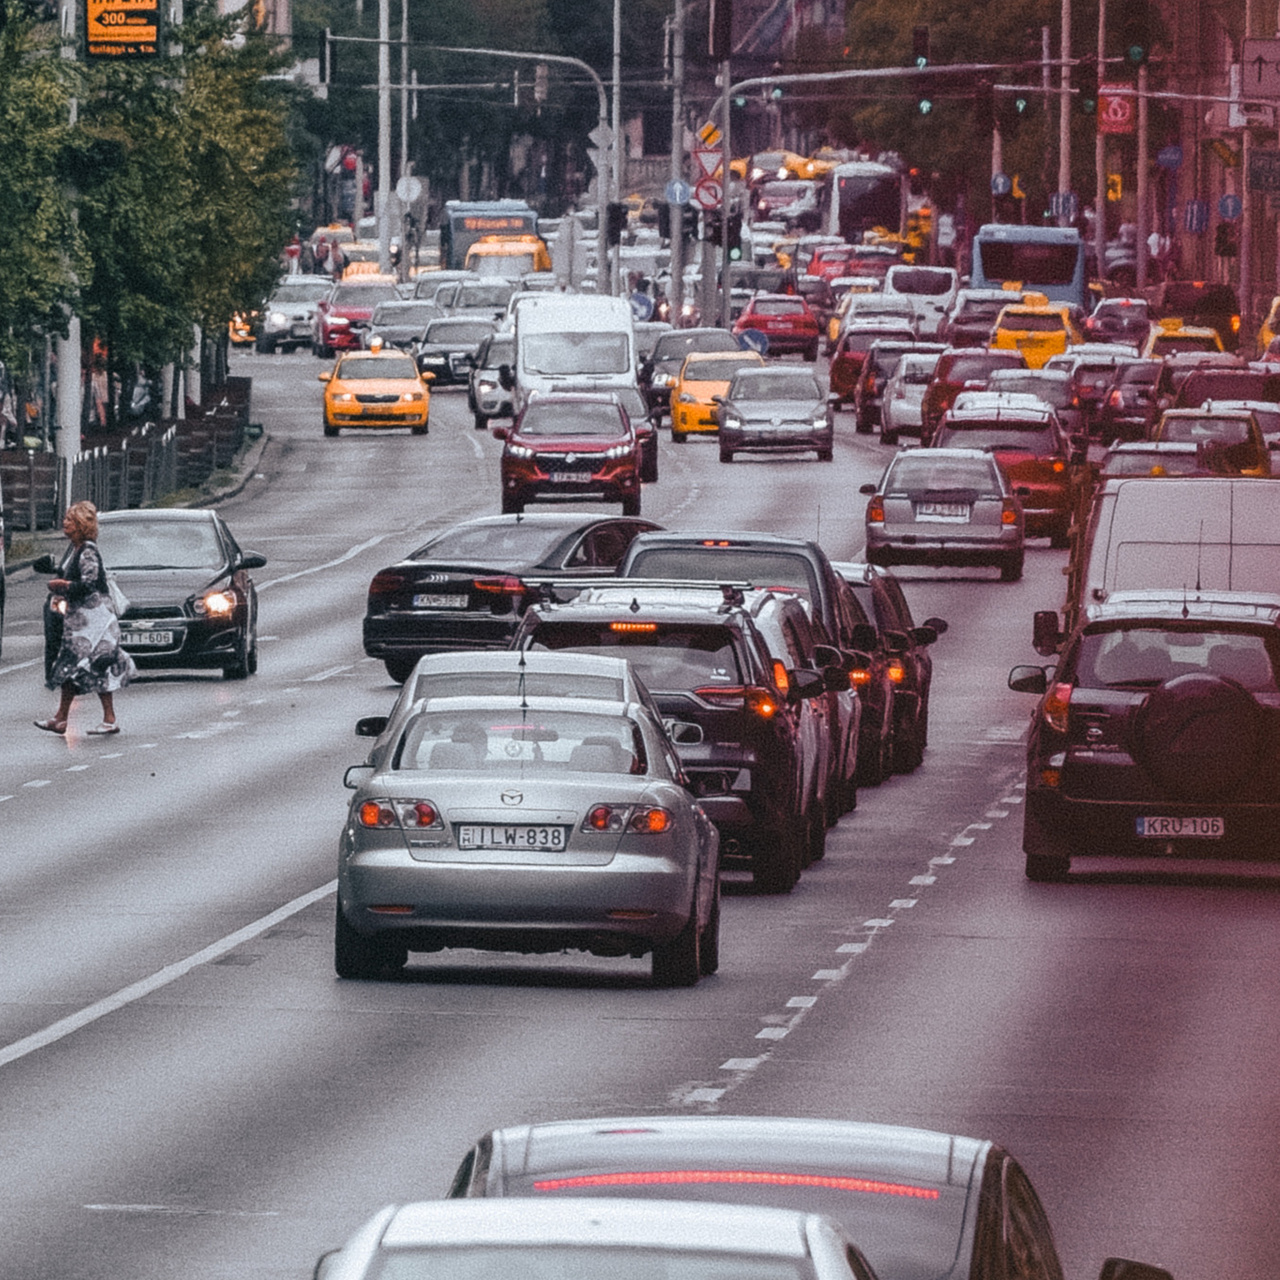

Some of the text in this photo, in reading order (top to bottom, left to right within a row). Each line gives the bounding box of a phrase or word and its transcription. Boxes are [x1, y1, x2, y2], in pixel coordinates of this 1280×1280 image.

[102, 12, 126, 25] 300
[1147, 818, 1221, 834] KRU-106
[480, 827, 562, 847] ILW-838
